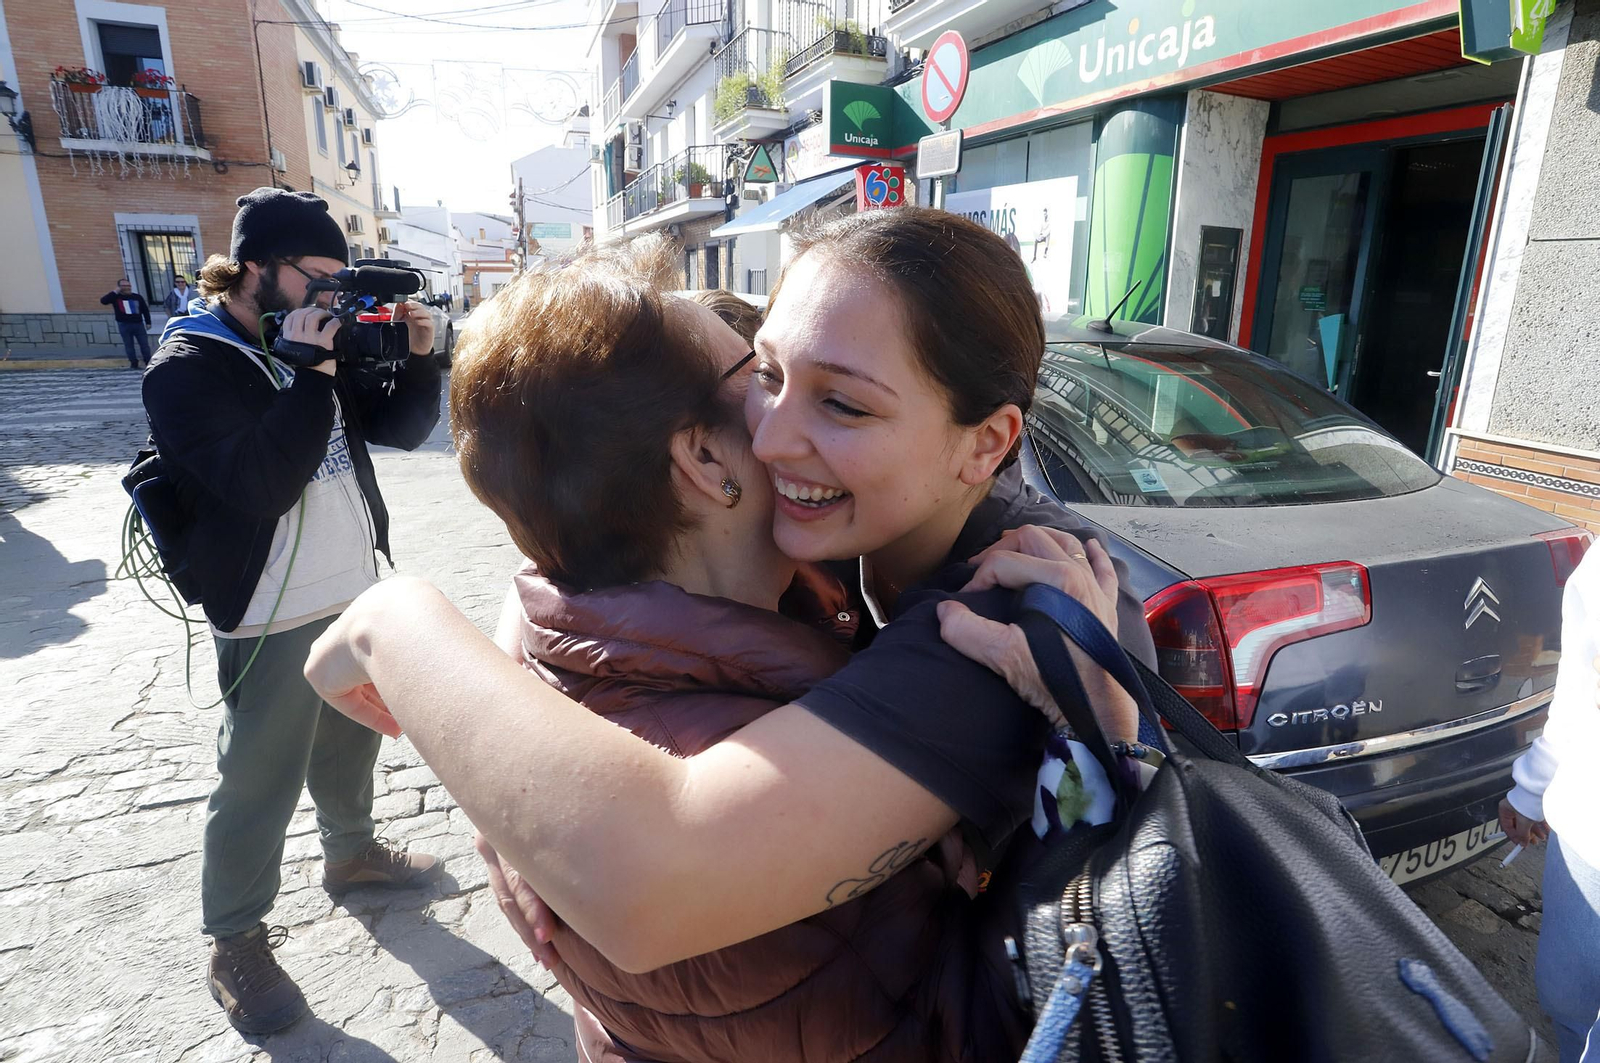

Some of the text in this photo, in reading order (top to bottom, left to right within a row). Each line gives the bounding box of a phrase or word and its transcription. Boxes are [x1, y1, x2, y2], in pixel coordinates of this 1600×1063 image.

[1078, 1, 1217, 83] Unicaja
[844, 131, 879, 147] Unicaja
[990, 202, 1017, 236] MÁS
[1266, 700, 1383, 727] CITROËN
[1387, 838, 1457, 878] 7505
